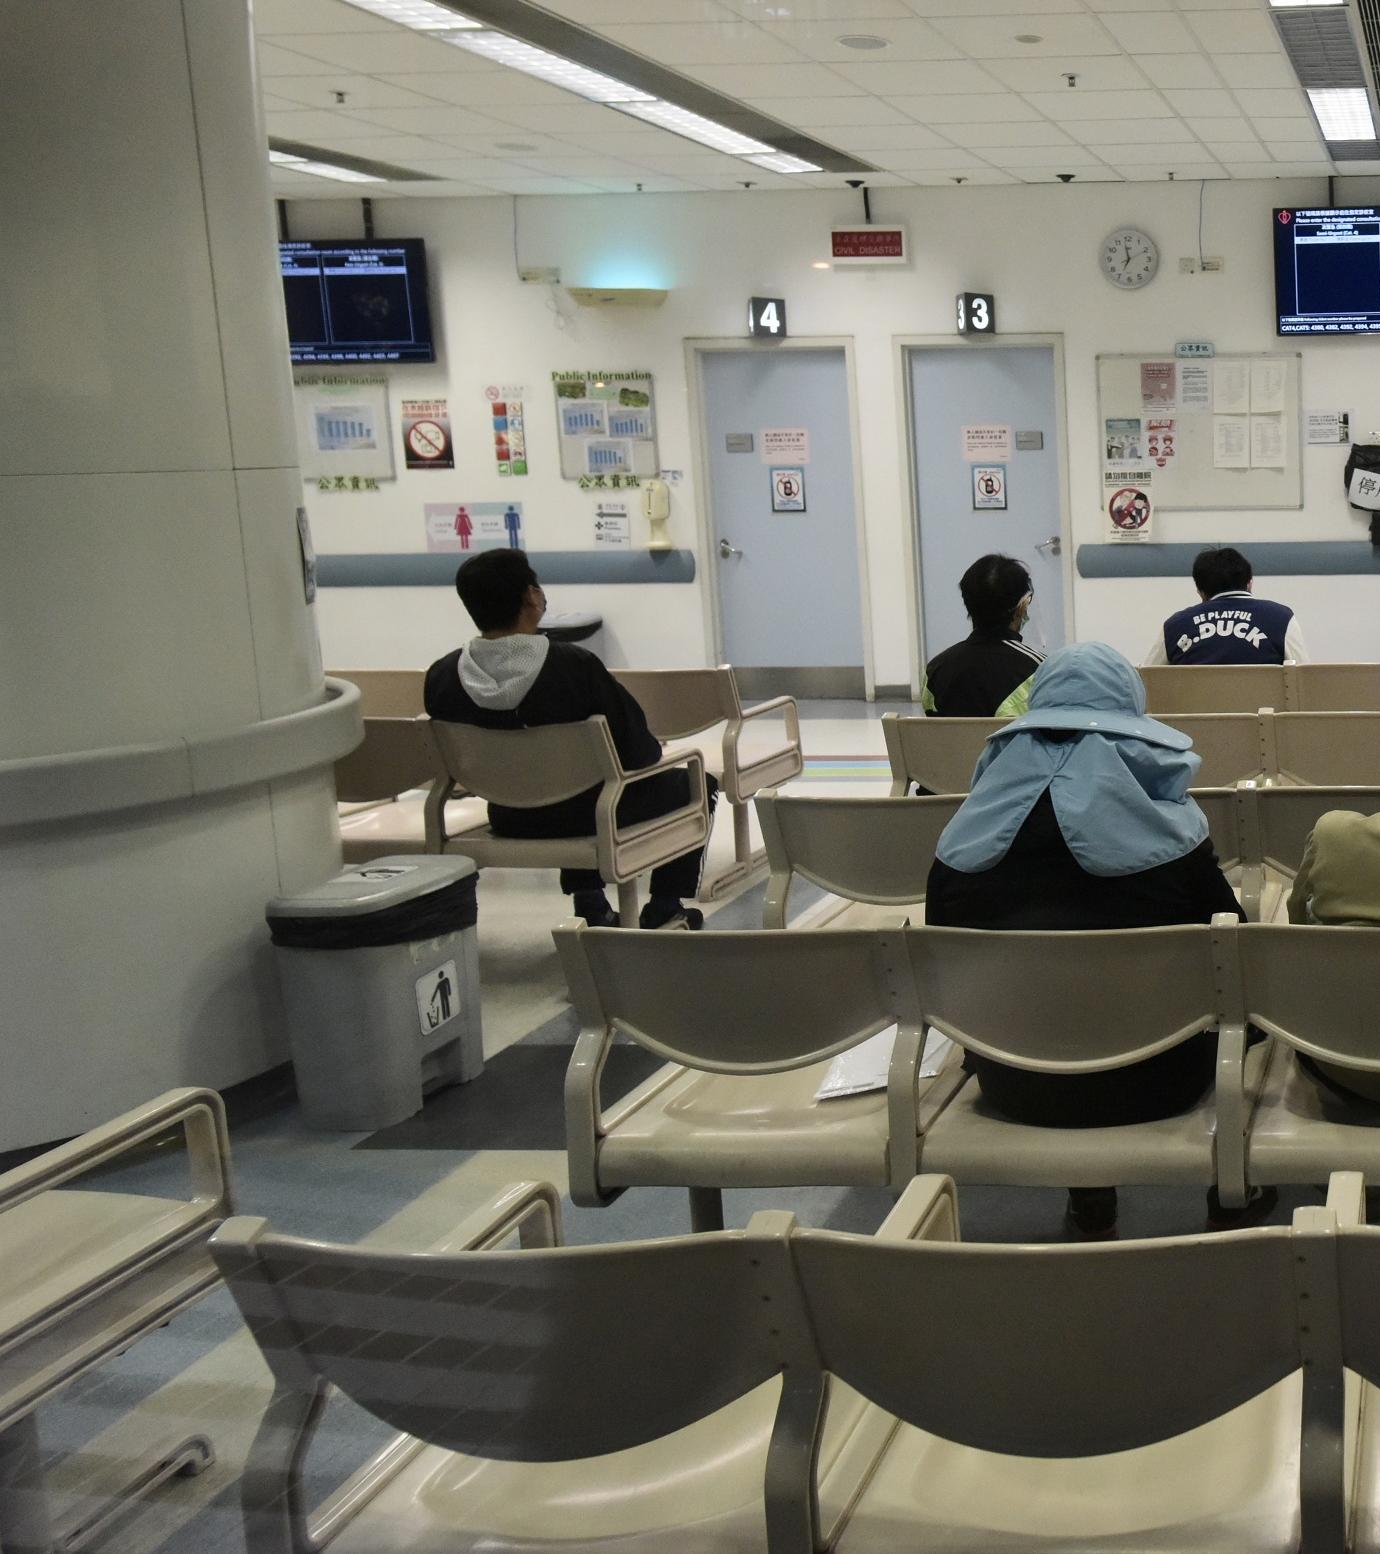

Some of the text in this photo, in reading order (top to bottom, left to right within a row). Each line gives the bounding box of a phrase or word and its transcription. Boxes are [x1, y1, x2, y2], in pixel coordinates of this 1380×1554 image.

[760, 302, 780, 333] 4
[958, 299, 965, 329] 3
[972, 298, 989, 329] 3
[294, 375, 386, 385] ublic Information
[551, 370, 652, 382] Public Information
[318, 476, 379, 490] 公眾資訊
[578, 475, 640, 488] 公眾資訊
[1193, 610, 1252, 625] BE PLAYFUL
